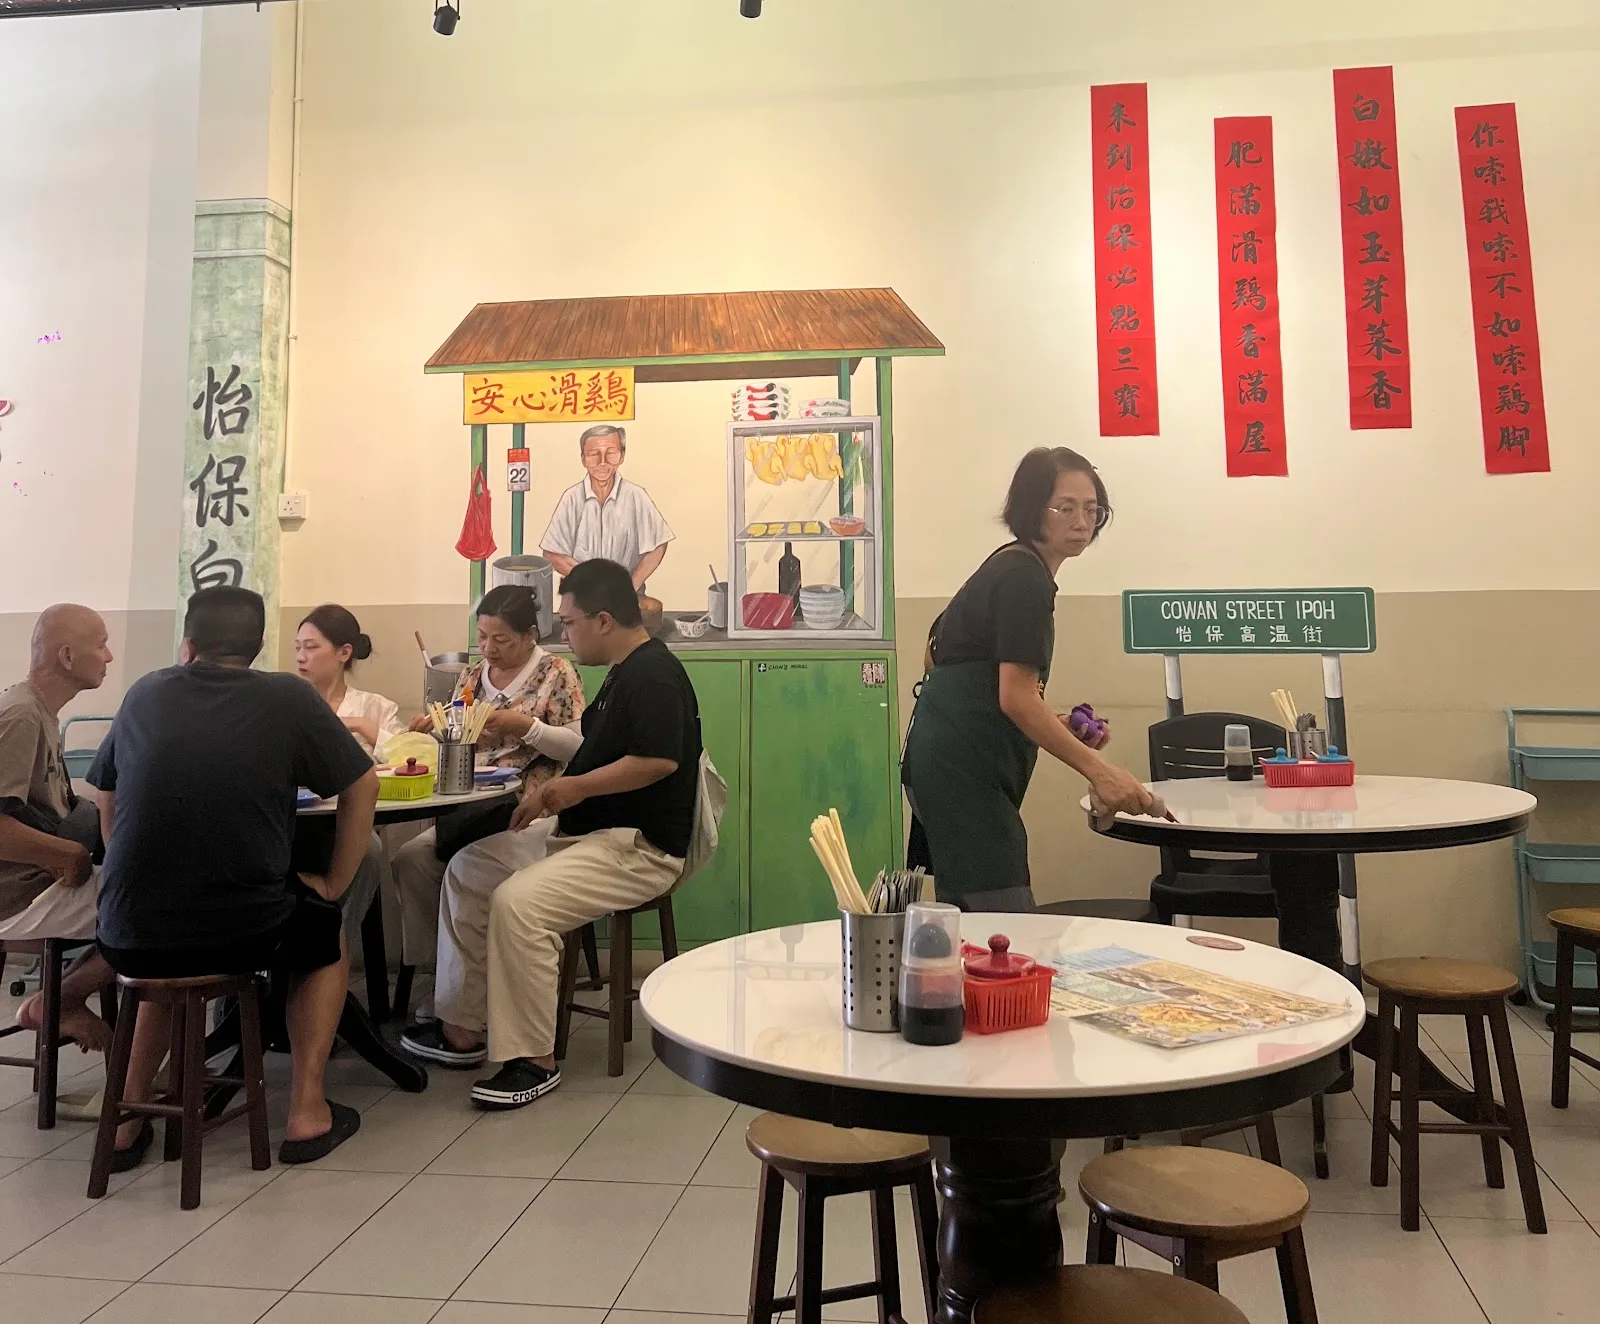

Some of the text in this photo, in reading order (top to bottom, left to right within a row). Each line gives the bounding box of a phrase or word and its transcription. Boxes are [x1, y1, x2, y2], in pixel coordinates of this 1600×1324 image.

[1346, 94, 1402, 411] 白嫩如玉芽菜香
[510, 467, 527, 484] 22
[1161, 600, 1336, 620] COWAN STREET IPOH
[511, 1087, 539, 1103] crocs
